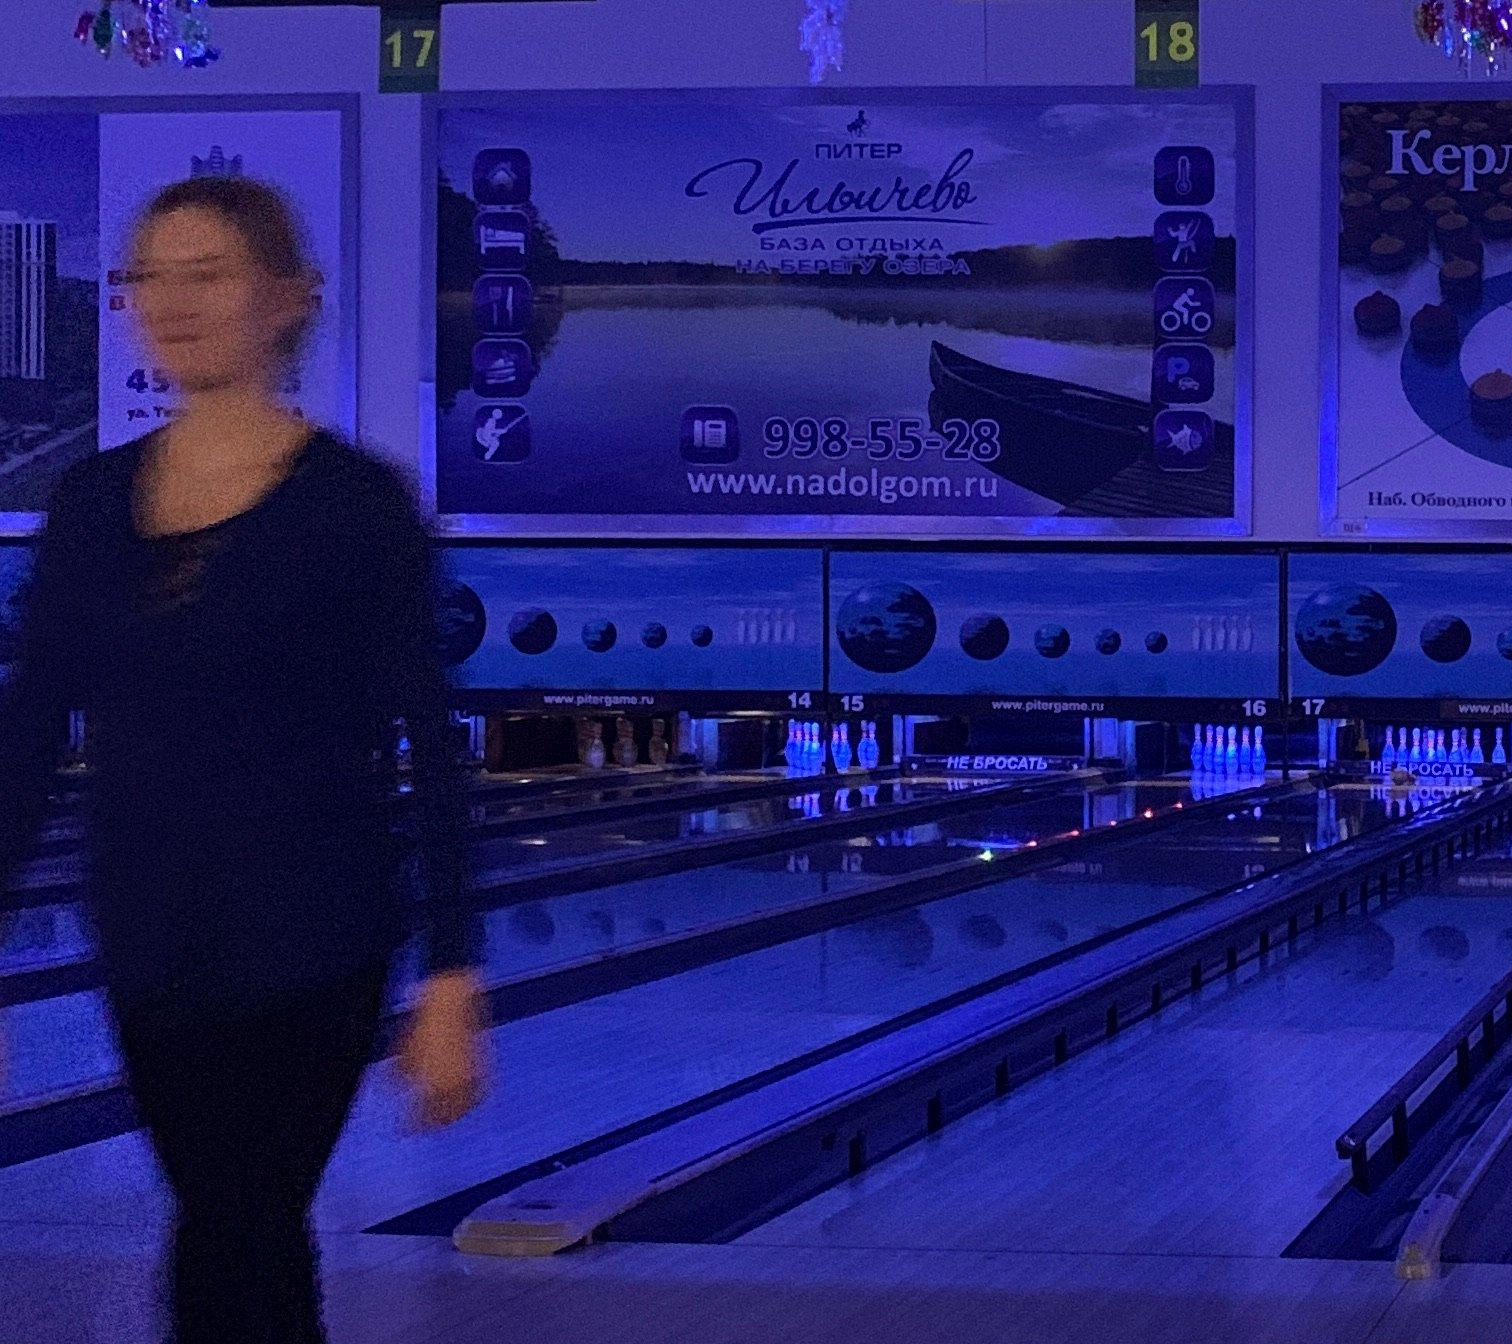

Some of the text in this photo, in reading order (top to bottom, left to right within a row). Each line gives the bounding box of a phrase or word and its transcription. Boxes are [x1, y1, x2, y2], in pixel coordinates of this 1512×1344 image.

[386, 31, 434, 68] 17
[1140, 22, 1194, 61] 18
[815, 144, 902, 159] ПИТЕР
[685, 148, 976, 217] Ильичево
[760, 236, 944, 253] БАЗА ОТДЫХА
[736, 256, 971, 275] НА БЕРЕГУ ОЗЕРА
[762, 417, 1000, 461] 998-55-28
[688, 468, 998, 502] www.nadolgom.ru
[1369, 492, 1407, 507] Наб.
[1411, 493, 1506, 510] Обводного
[543, 693, 654, 707] www.pitergame.ru
[788, 693, 811, 708] 14
[840, 696, 864, 711] 15
[992, 699, 1104, 712] www.pitergame.ru
[1241, 700, 1266, 716] 16
[1302, 699, 1325, 715] 17
[947, 756, 1047, 769] НЕ БРОСАТЬ
[1370, 761, 1391, 774] НЕ
